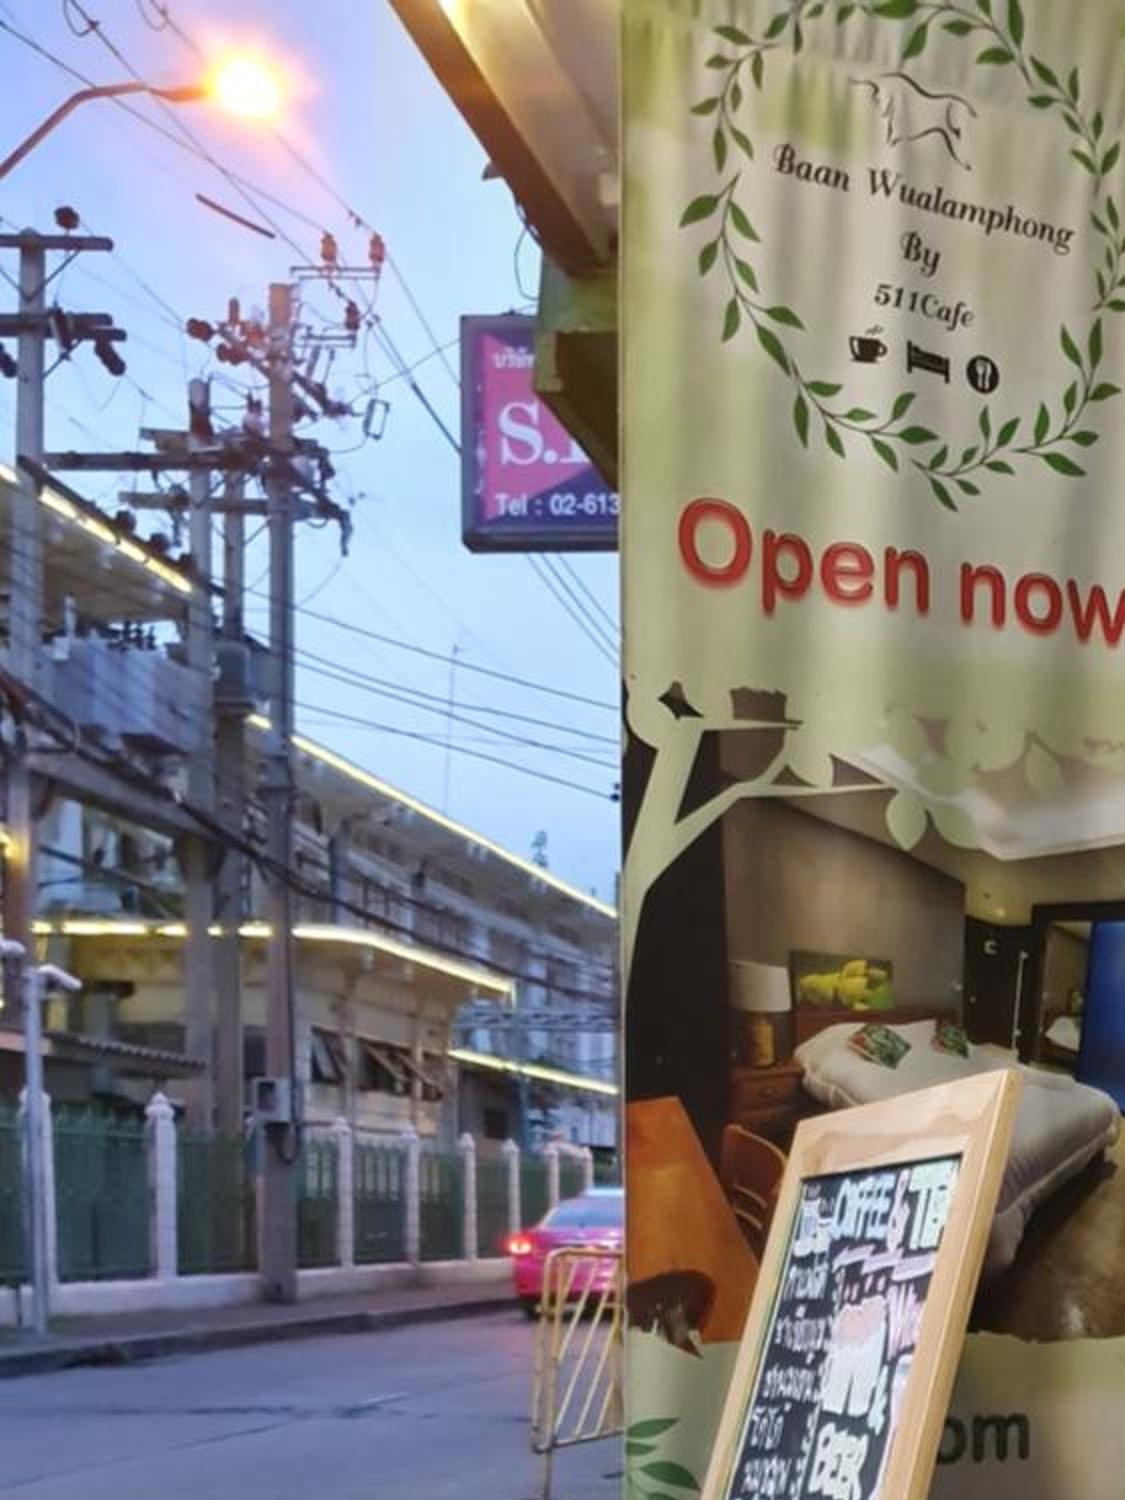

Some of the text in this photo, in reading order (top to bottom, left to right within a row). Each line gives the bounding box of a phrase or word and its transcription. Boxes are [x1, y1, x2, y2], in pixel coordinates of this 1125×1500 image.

[773, 143, 1075, 256] Baan Wualamphong
[902, 231, 941, 275] By
[873, 284, 974, 331] 511Cafe
[496, 494, 528, 515] Tel
[678, 497, 930, 618] Open
